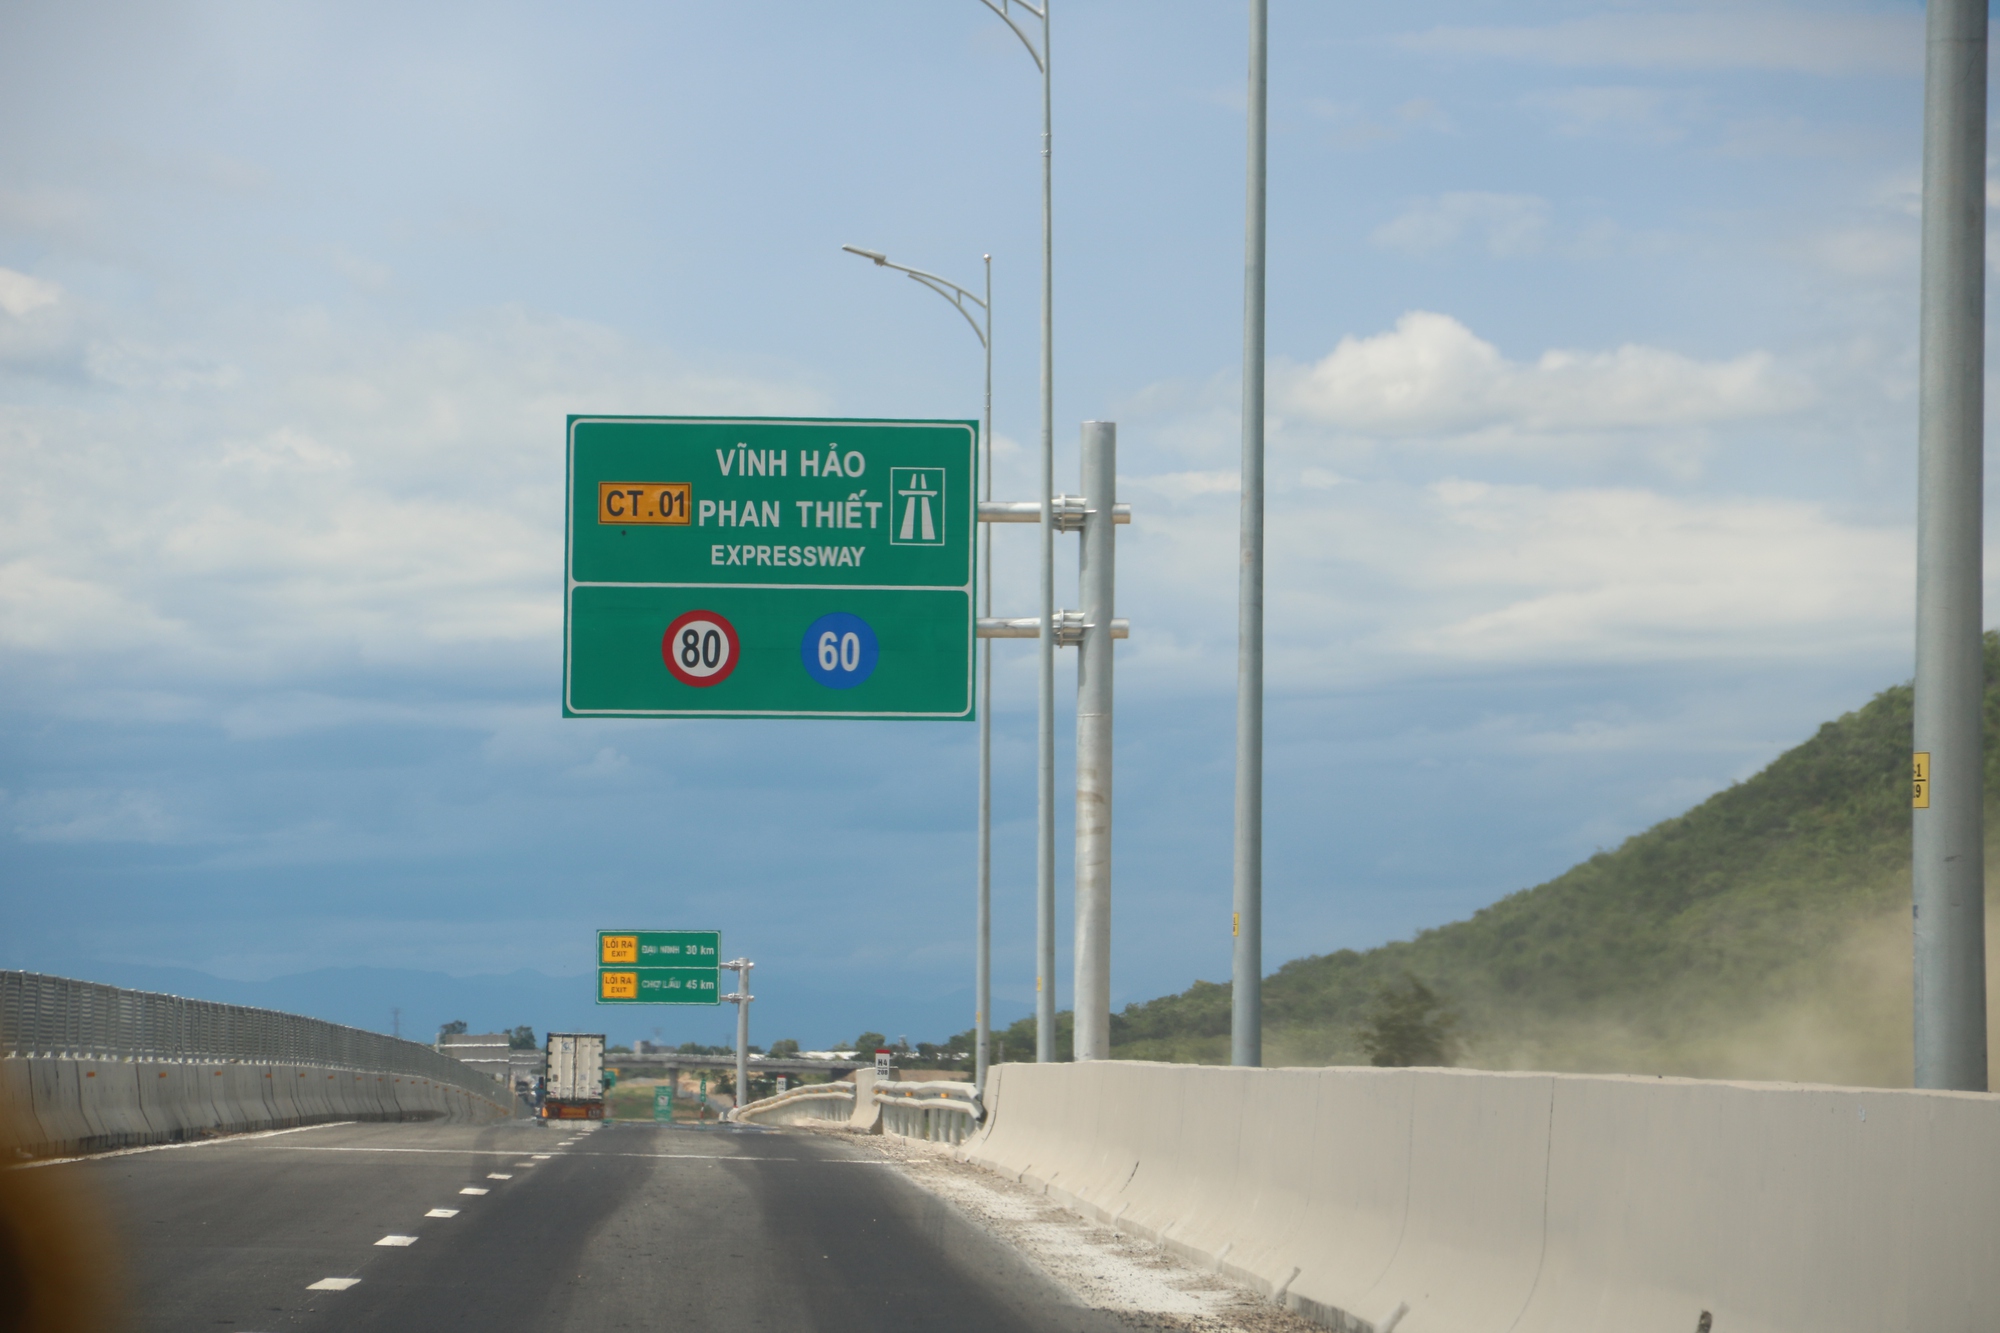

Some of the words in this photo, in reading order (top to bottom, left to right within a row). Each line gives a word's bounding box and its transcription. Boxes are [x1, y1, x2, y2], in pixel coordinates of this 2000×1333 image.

[716, 442, 787, 477] VĨNH
[800, 442, 866, 478] HẢO
[606, 490, 685, 517] CT.01
[698, 499, 780, 527] PHAN
[796, 489, 883, 528] THIẾT
[711, 544, 866, 567] EXPRESSWAY
[681, 628, 722, 669] 80
[818, 631, 860, 671] 60
[622, 940, 633, 949] RA
[685, 945, 697, 955] 30
[700, 946, 714, 955] km
[620, 976, 632, 984] RA
[685, 980, 698, 989] 45
[700, 980, 714, 989] km
